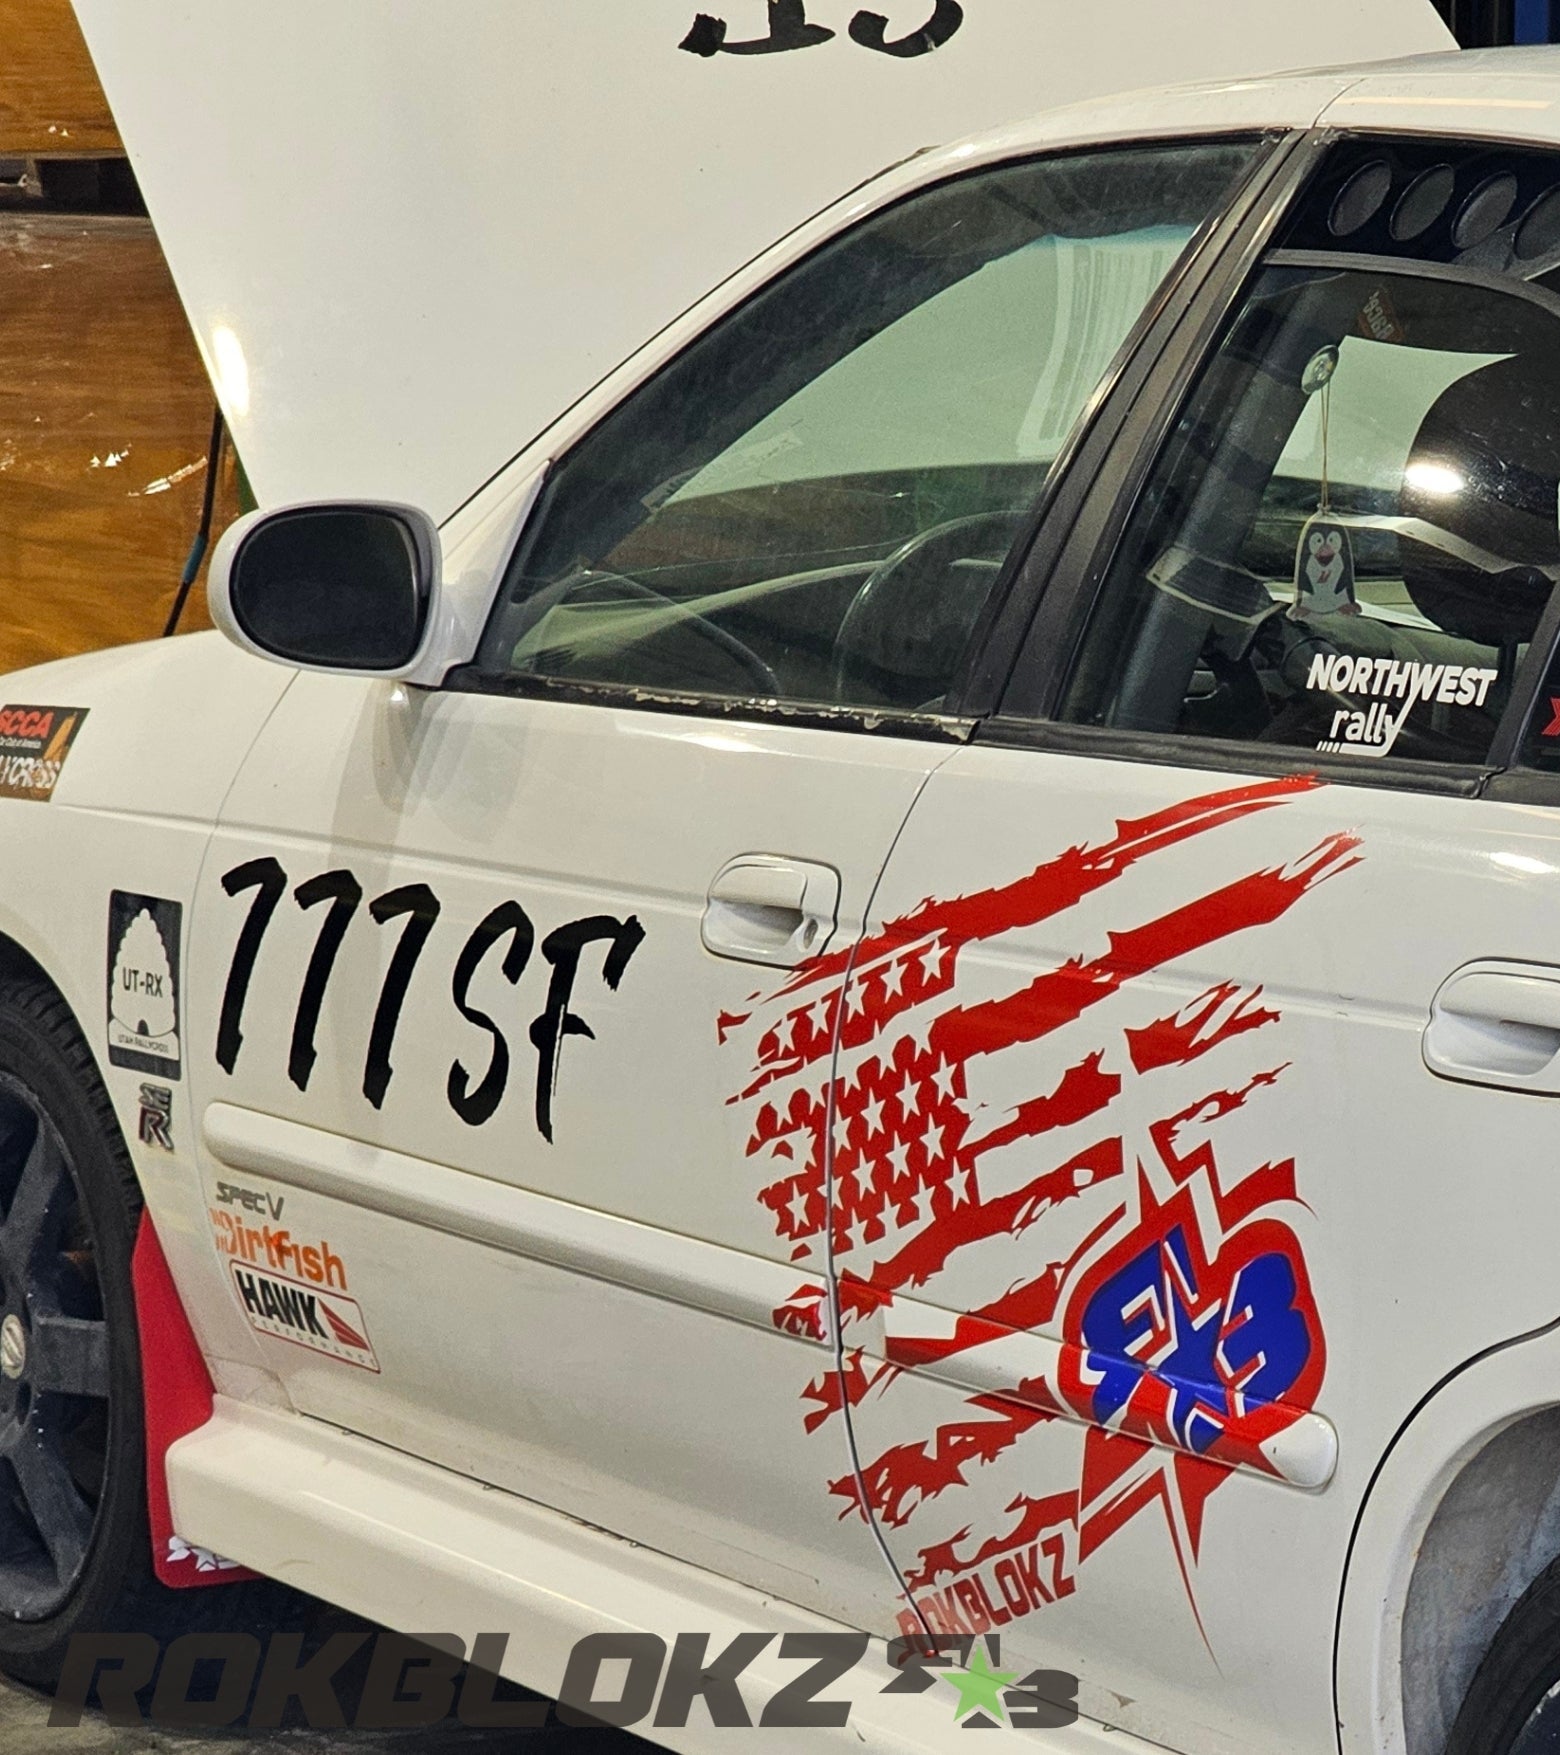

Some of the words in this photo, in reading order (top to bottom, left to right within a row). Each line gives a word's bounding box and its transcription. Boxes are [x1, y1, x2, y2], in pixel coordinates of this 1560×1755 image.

[1306, 653, 1498, 708] NORTHWEST
[1317, 703, 1402, 757] rally
[122, 965, 164, 999] UT-RX
[234, 1268, 330, 1341] HAWK
